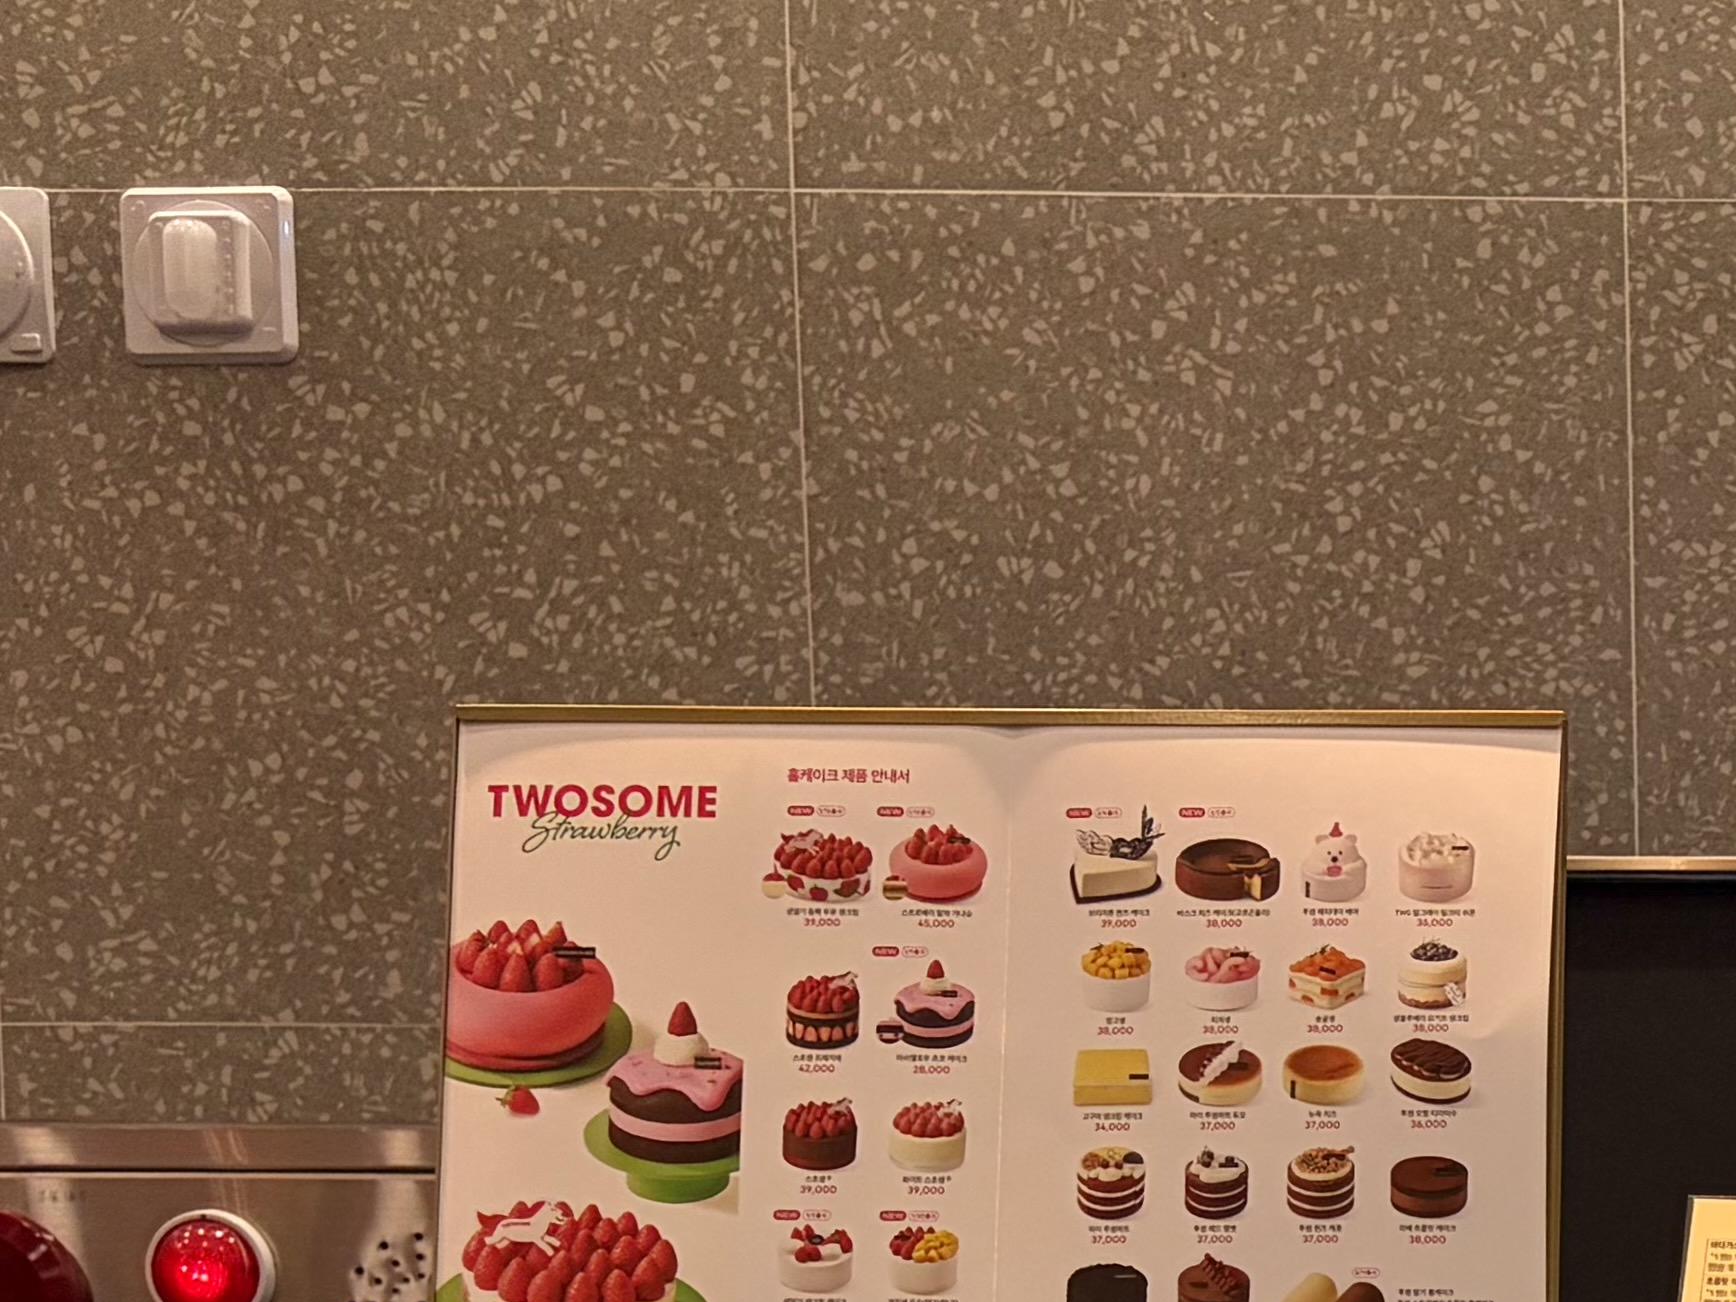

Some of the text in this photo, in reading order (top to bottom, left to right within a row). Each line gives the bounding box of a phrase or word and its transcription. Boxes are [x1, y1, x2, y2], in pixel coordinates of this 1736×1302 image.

[787, 768, 911, 784] 홀케이크 제품 안내서
[488, 784, 717, 819] TWOSOME
[522, 812, 680, 861] Strawberry
[917, 919, 955, 928] 45,000
[800, 1185, 837, 1195] 39,000
[907, 1186, 945, 1195] 39,000
